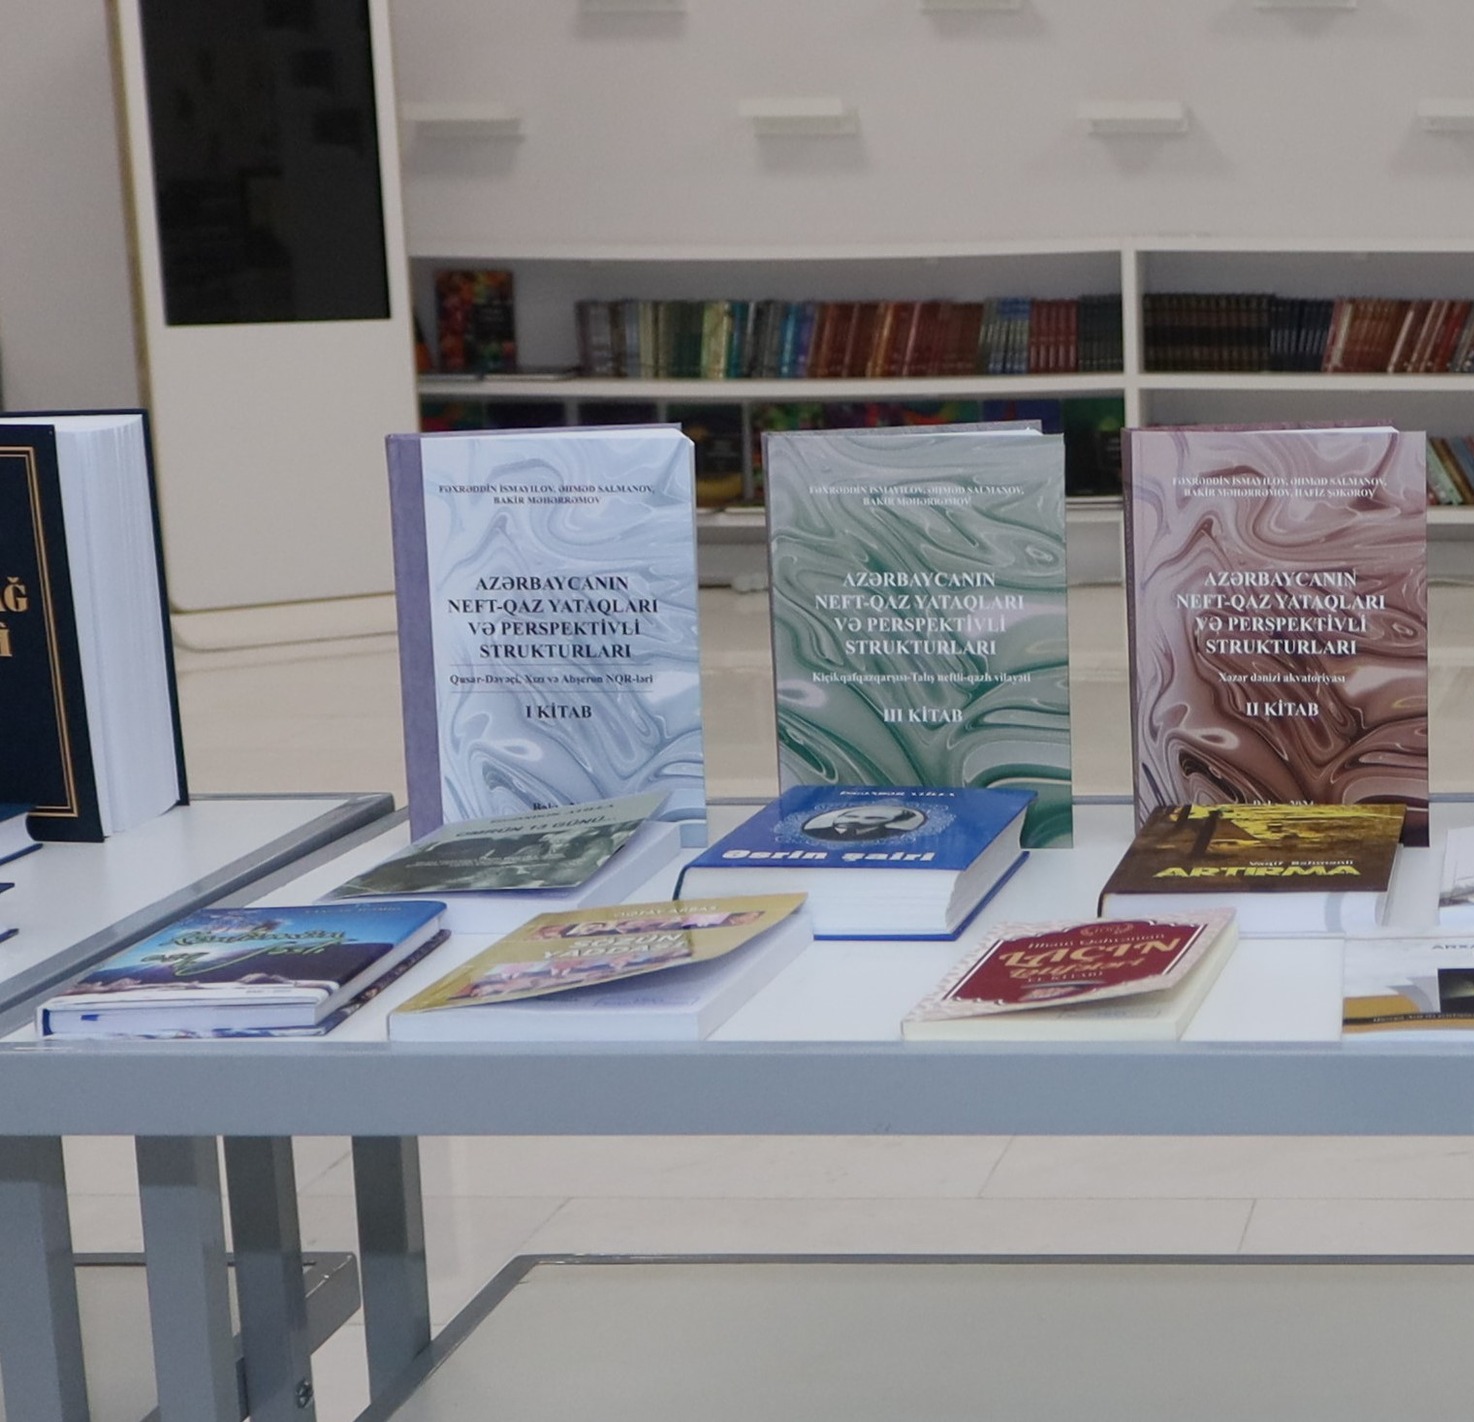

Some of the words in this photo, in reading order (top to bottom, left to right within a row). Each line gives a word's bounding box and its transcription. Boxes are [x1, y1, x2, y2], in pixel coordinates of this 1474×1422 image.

[475, 576, 630, 591] AZƏRBAYCANIN
[842, 572, 996, 588] AZƏRBAYCANIN
[1203, 572, 1357, 587] AZƏRBAYCANIN
[447, 599, 545, 615] NEFT-QAZ
[549, 599, 659, 614] YATAQLARI
[814, 594, 911, 612] NEFT-QAZ
[914, 594, 1025, 611] YATAQLARI
[1176, 594, 1272, 611] NEFT-QAZ
[1274, 594, 1386, 611] YATAQLARI
[468, 621, 496, 636] VƏ
[501, 619, 641, 636] PERSPEKTİVLİ
[834, 617, 862, 632] VƏ
[866, 614, 1007, 633] PERSPEKTİVLİ
[1194, 617, 1223, 632] VƏ
[1227, 614, 1367, 632] PERSPEKTİVLİ
[479, 644, 632, 659] STRUKTURLARI
[845, 640, 997, 656] STRUKTURLARI
[1205, 639, 1357, 655] STRUKTURLARI
[537, 702, 593, 719] KİTAB
[883, 708, 903, 723] III
[907, 705, 964, 723] KİTAB
[1246, 702, 1259, 717] II
[1264, 699, 1319, 717] KİTAB
[1152, 865, 1362, 878] ARTIRMA
